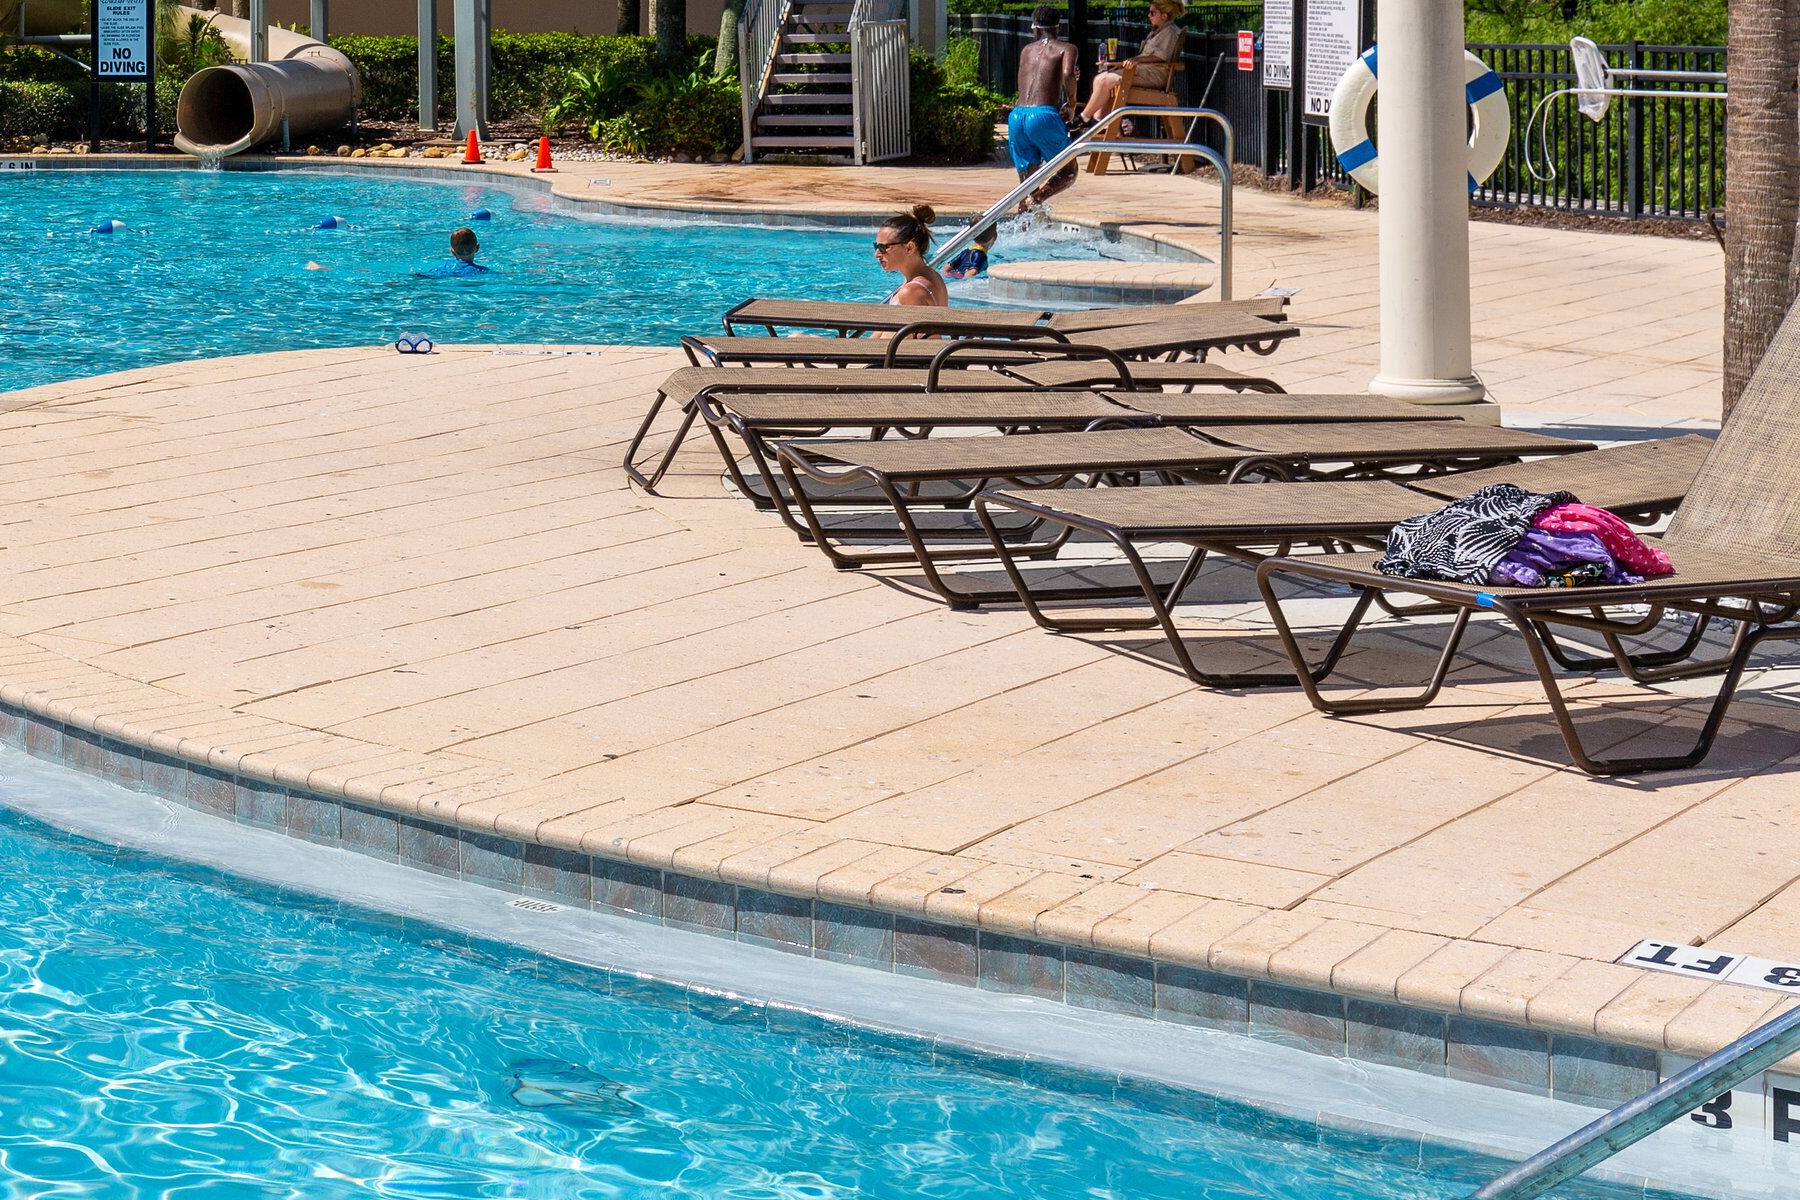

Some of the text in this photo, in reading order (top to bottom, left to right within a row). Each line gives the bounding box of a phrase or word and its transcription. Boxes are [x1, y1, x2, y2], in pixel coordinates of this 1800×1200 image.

[112, 48, 132, 60] NO
[100, 61, 146, 73] DIVING
[1265, 64, 1290, 79] NO DIVING
[1310, 98, 1322, 113] NO
[1763, 966, 1800, 987] 3
